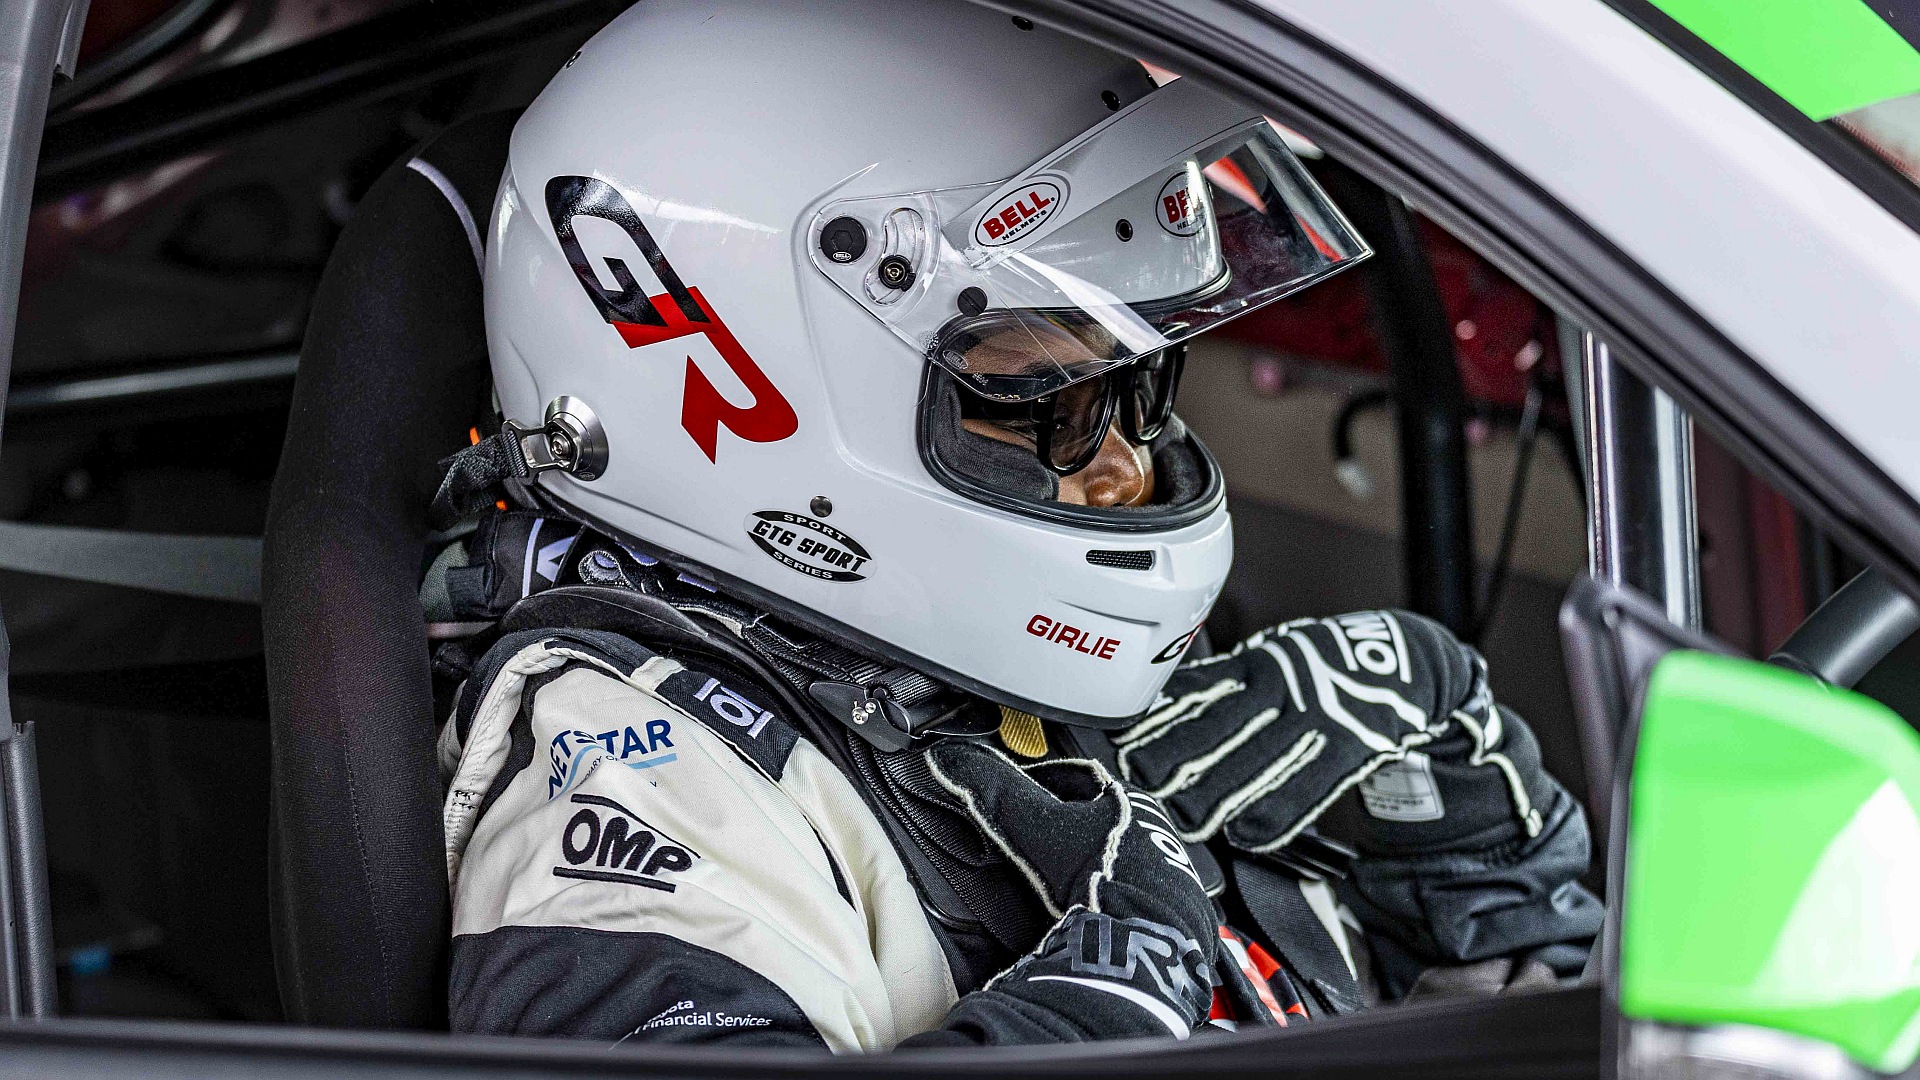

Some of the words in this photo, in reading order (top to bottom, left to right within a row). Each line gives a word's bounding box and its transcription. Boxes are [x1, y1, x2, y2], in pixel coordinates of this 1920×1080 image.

[1002, 209, 1048, 241] HELMETS
[783, 513, 847, 541] SPORT
[753, 520, 797, 547] GT6
[797, 538, 867, 572] SPORT
[773, 551, 833, 579] SERIES
[1026, 614, 1121, 660] GIRLIE
[562, 808, 693, 876] OMP
[715, 1012, 773, 1028] Services
